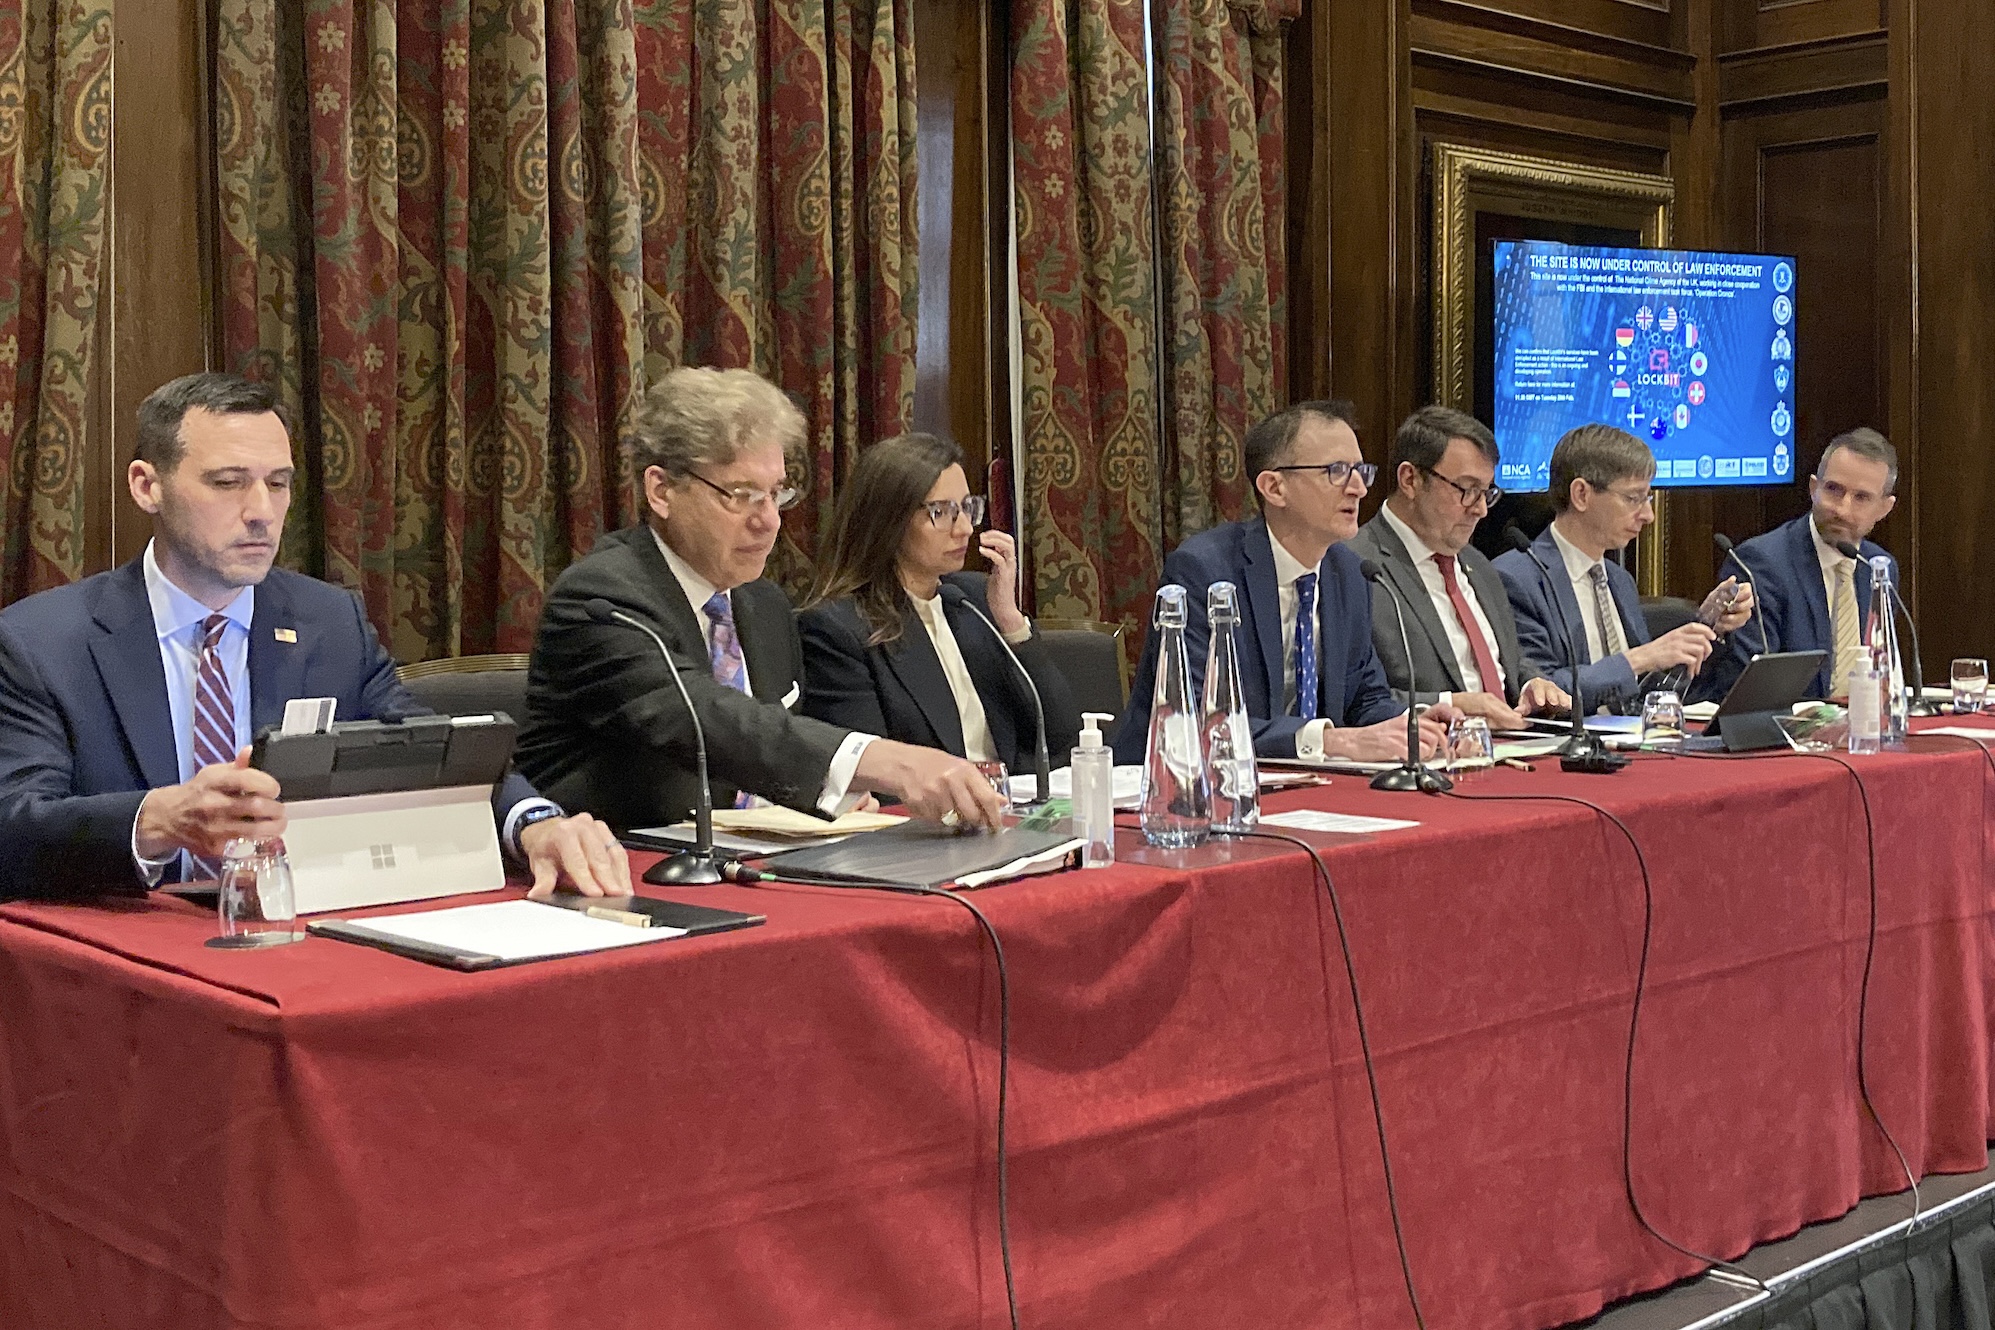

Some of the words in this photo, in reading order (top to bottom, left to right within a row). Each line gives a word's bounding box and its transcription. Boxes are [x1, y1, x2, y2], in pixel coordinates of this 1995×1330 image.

[1530, 255, 1548, 268] THE
[1549, 256, 1568, 269] SITE
[1570, 257, 1578, 269] IS
[1580, 257, 1600, 270] NOW
[1602, 258, 1631, 271] UNDER
[1632, 259, 1671, 274] CONTROL
[1672, 261, 1684, 274] OF
[1685, 262, 1704, 275] LAW
[1705, 263, 1762, 277] ENFORCEMENT
[1530, 271, 1540, 280] This
[1582, 274, 1590, 282] the
[1591, 274, 1607, 282] control
[1615, 275, 1624, 283] The
[1625, 275, 1644, 284] National
[1645, 276, 1658, 284] Crime
[1659, 276, 1676, 287] Agency
[1576, 284, 1585, 292] FBI
[1638, 373, 1679, 386] LOCKBIT
[1511, 463, 1531, 476] NCA
